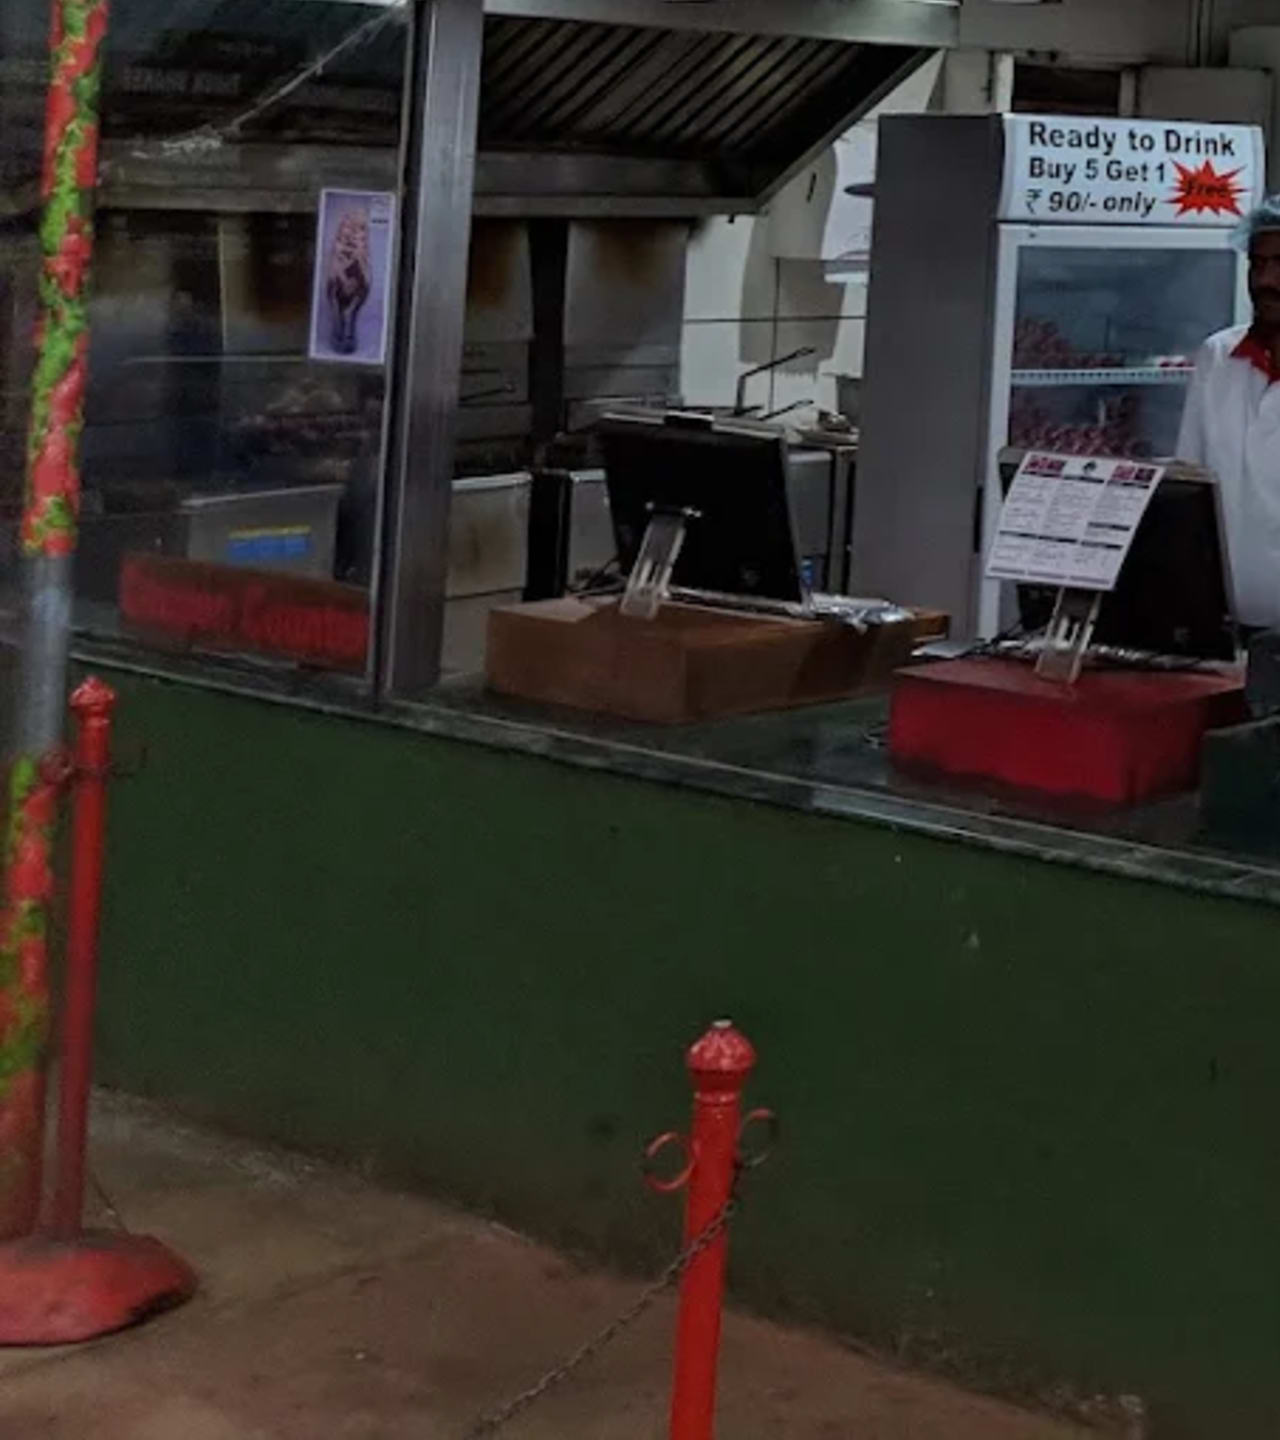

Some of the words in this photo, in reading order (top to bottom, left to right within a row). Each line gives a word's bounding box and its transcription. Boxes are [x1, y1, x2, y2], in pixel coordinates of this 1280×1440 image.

[1029, 122, 1116, 156] Ready
[1128, 130, 1154, 151] to
[1165, 129, 1235, 157] Drink
[1029, 157, 1076, 184] Buy
[1085, 159, 1098, 179] 5
[1106, 160, 1148, 182] Get
[1156, 163, 1165, 183] 1
[1026, 189, 1042, 214] ₹
[1049, 192, 1097, 212] 90/-
[1103, 192, 1156, 217] only
